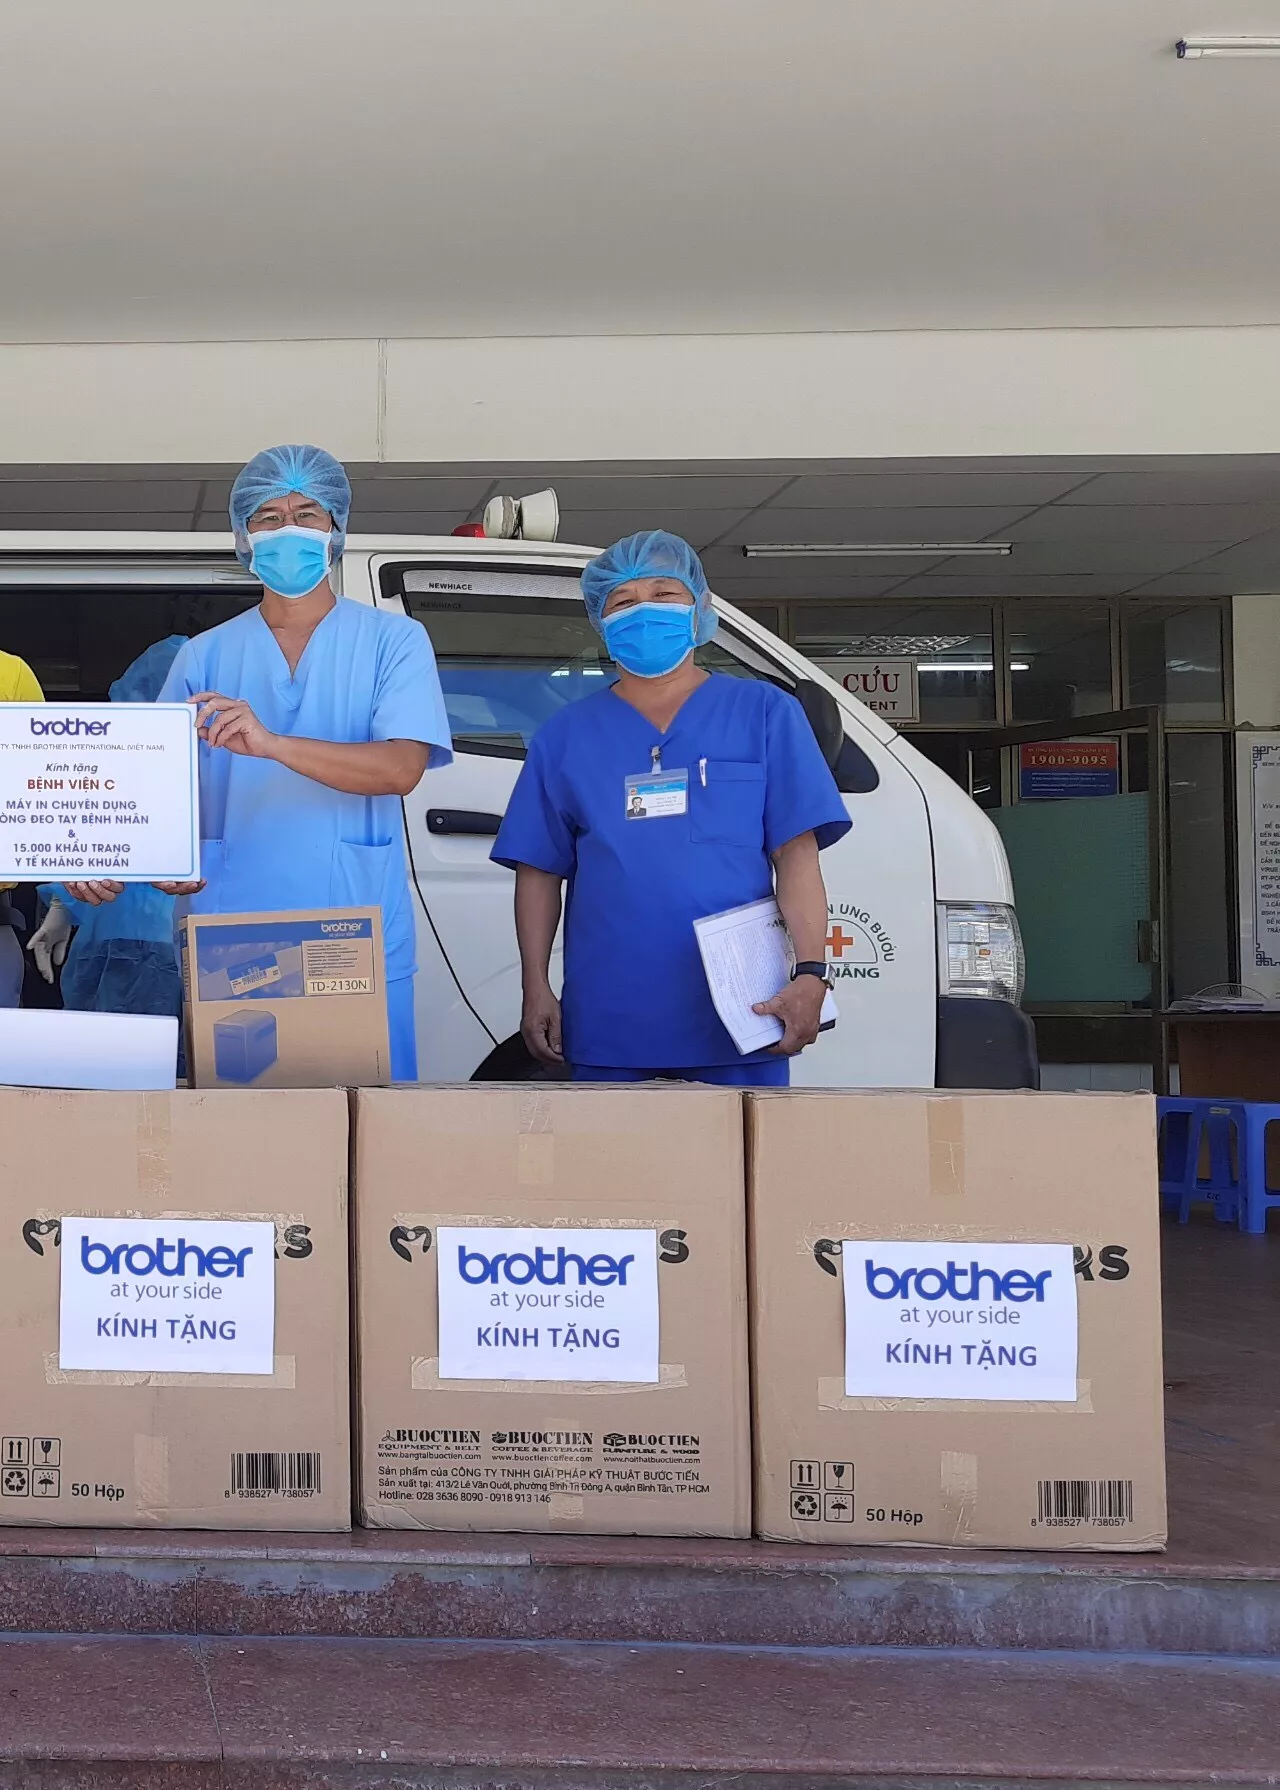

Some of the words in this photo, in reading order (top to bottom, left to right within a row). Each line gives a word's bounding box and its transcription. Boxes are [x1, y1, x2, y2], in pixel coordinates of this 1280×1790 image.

[429, 582, 473, 590] NEWHIACE
[843, 665, 900, 693] CỨU
[30, 718, 111, 736] brother
[1030, 755, 1107, 765] 1900-9095
[46, 763, 70, 772] Kính
[73, 763, 98, 775] tặng
[27, 776, 64, 793] BỆNH
[69, 776, 100, 793] VIỆN
[104, 779, 115, 790] C
[6, 798, 33, 810] MÁY
[36, 800, 48, 810] IN
[51, 799, 99, 810] CHUYÊN
[103, 800, 137, 812] DỤNG
[30, 815, 54, 824] ĐEO
[59, 815, 77, 824] TAY
[81, 812, 111, 826] BỆNH
[115, 813, 149, 824] NHÂN
[68, 830, 76, 838] &
[13, 843, 52, 853] 15.000
[55, 838, 88, 853] KHẨU
[91, 844, 131, 853] TRANG
[15, 858, 22, 867] Y
[25, 854, 39, 867] TẾ
[88, 853, 129, 867] KHUẨN
[321, 922, 363, 933] brother
[840, 903, 871, 924] UNG
[870, 921, 898, 962] BƯỚU
[310, 980, 367, 992] TD-2130N
[81, 1236, 253, 1277] brother
[458, 1245, 634, 1286] brother
[865, 1259, 1052, 1302] brother
[110, 1282, 129, 1297] at
[136, 1283, 179, 1301] your
[183, 1282, 222, 1299] side
[490, 1291, 509, 1307] at
[516, 1293, 560, 1311] your
[564, 1291, 605, 1308] side
[900, 1306, 920, 1322] at
[927, 1308, 973, 1327] your
[978, 1306, 1020, 1324] side
[97, 1313, 156, 1337] KÍNH
[167, 1313, 236, 1343] TẶNG
[477, 1322, 538, 1347] KÍNH
[548, 1323, 620, 1352] TẶNG
[885, 1338, 951, 1364] KÍNH
[961, 1340, 1037, 1370] TẶNG
[396, 1430, 480, 1443] BUOCTIEN
[508, 1432, 593, 1445] BUOCTIEN
[628, 1435, 700, 1446] BUOCTIEN
[71, 1484, 89, 1497] 50
[94, 1485, 125, 1501] Hộp
[225, 1490, 230, 1498] 8
[238, 1490, 272, 1498] 938527
[281, 1489, 315, 1498] 738057
[379, 1491, 414, 1500] Hotline:
[416, 1492, 434, 1500] 028
[436, 1492, 458, 1501] 3636
[460, 1492, 484, 1501] 8090
[490, 1493, 513, 1502] 0918
[515, 1493, 532, 1502] 913
[535, 1494, 551, 1503] 146
[866, 1508, 885, 1522] 50
[890, 1509, 923, 1526] Hộp
[1031, 1518, 1036, 1527] 8
[1046, 1518, 1081, 1527] 938527
[1091, 1518, 1125, 1527] 738057
